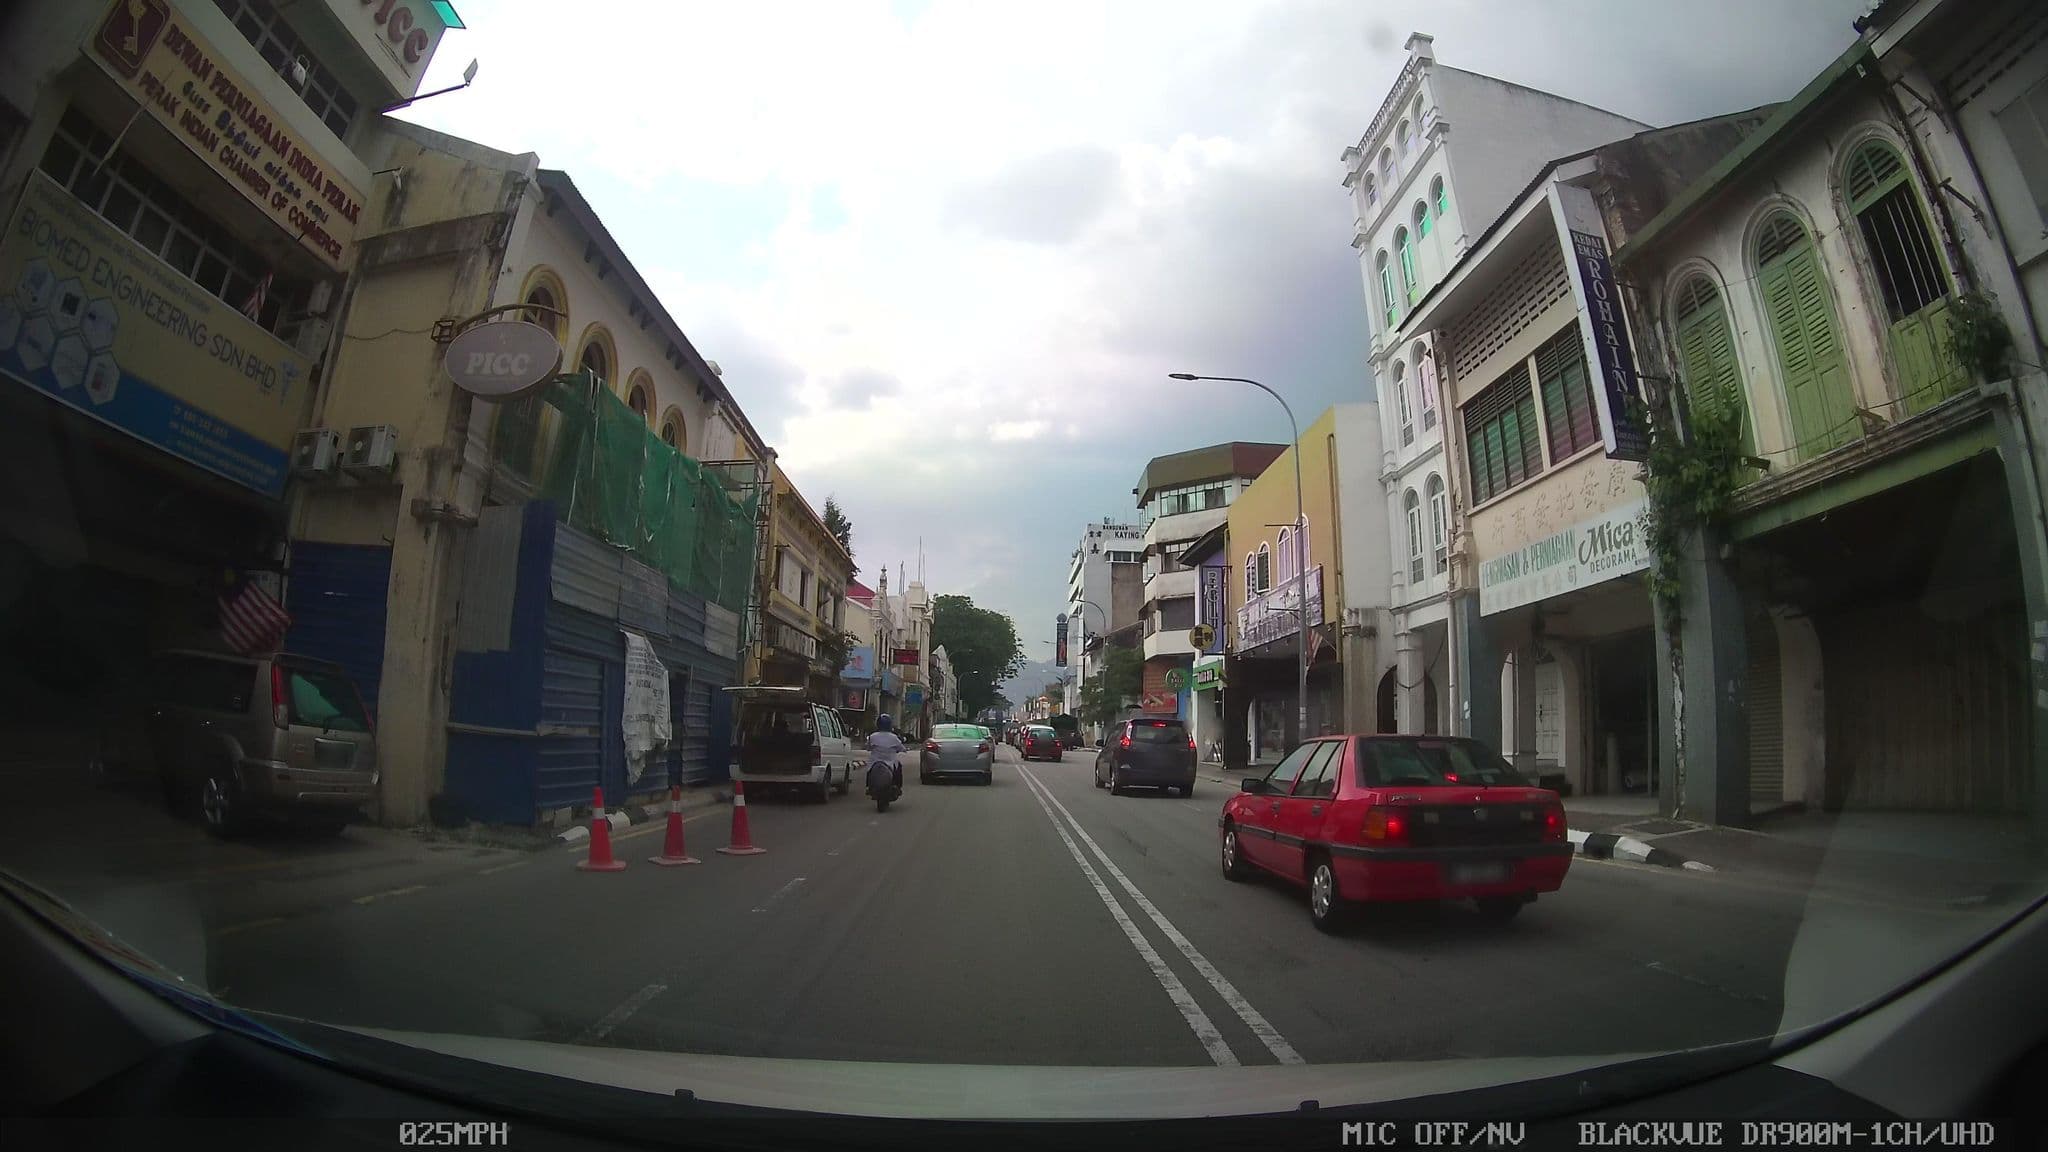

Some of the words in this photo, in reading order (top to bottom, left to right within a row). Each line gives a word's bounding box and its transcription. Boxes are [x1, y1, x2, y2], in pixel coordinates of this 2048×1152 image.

[362, 0, 428, 63] ICC
[163, 23, 214, 82] DEWAN
[210, 70, 291, 158] PERNIAGAAN
[287, 146, 324, 191] INDIA
[321, 178, 360, 226] PERAK
[137, 70, 180, 117] PERAK
[178, 108, 219, 152] INDIAN
[218, 143, 271, 199] CHAMBER
[269, 189, 288, 213] OF
[287, 203, 341, 261] COMMERCE
[1573, 232, 1602, 249] KEDAI
[1577, 243, 1604, 260] EMAS
[19, 207, 90, 273] BIOMED
[92, 254, 207, 347] ENGINEERING
[464, 352, 531, 376] PICC
[1522, 547, 1530, 575] &
[1530, 529, 1576, 574] PERNIAGAAN
[1578, 520, 1633, 565] Mica
[1590, 548, 1637, 574] DECORAMA
